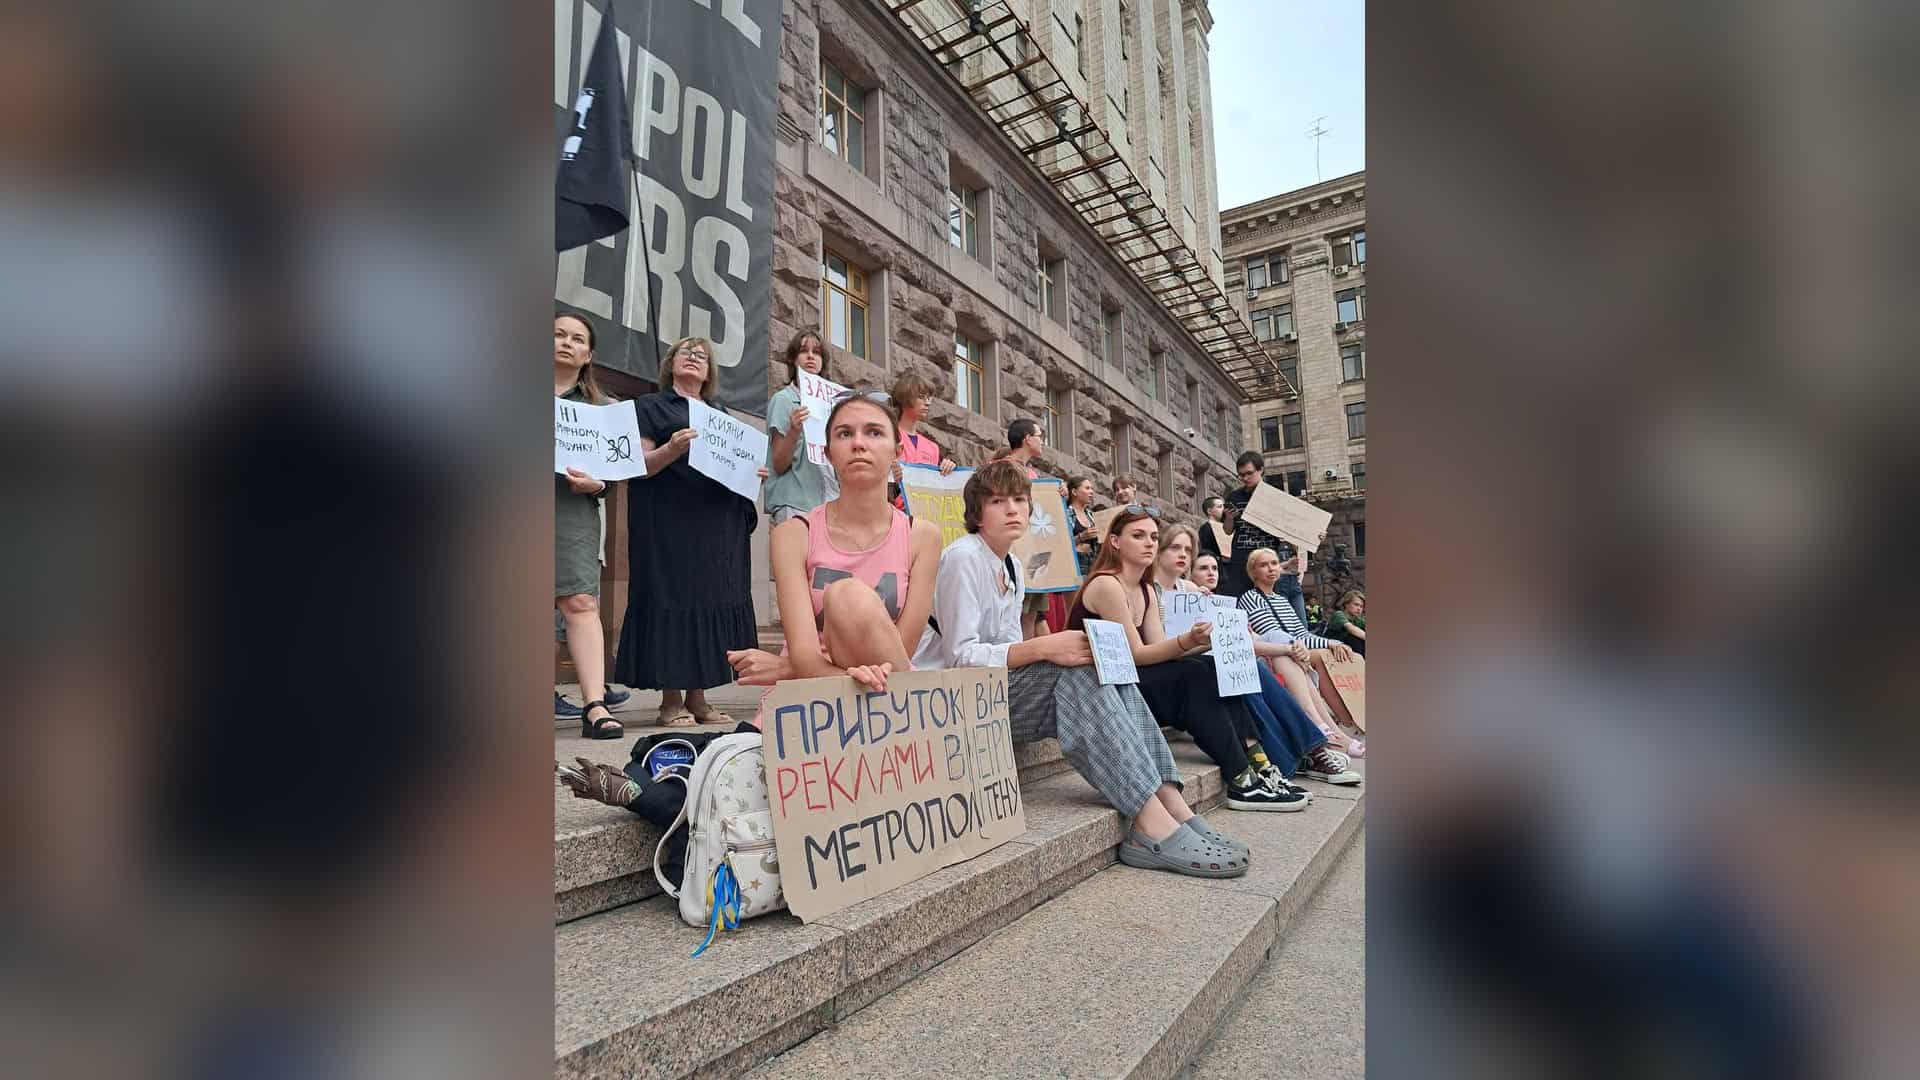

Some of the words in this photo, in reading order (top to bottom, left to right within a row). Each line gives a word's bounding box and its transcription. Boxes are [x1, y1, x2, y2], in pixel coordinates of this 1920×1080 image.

[708, 413, 744, 441] КИЯНИ
[775, 687, 964, 760] ПРИБУТОК
[975, 673, 1007, 720] ВІД
[777, 739, 934, 817] РЕКЛАМИ
